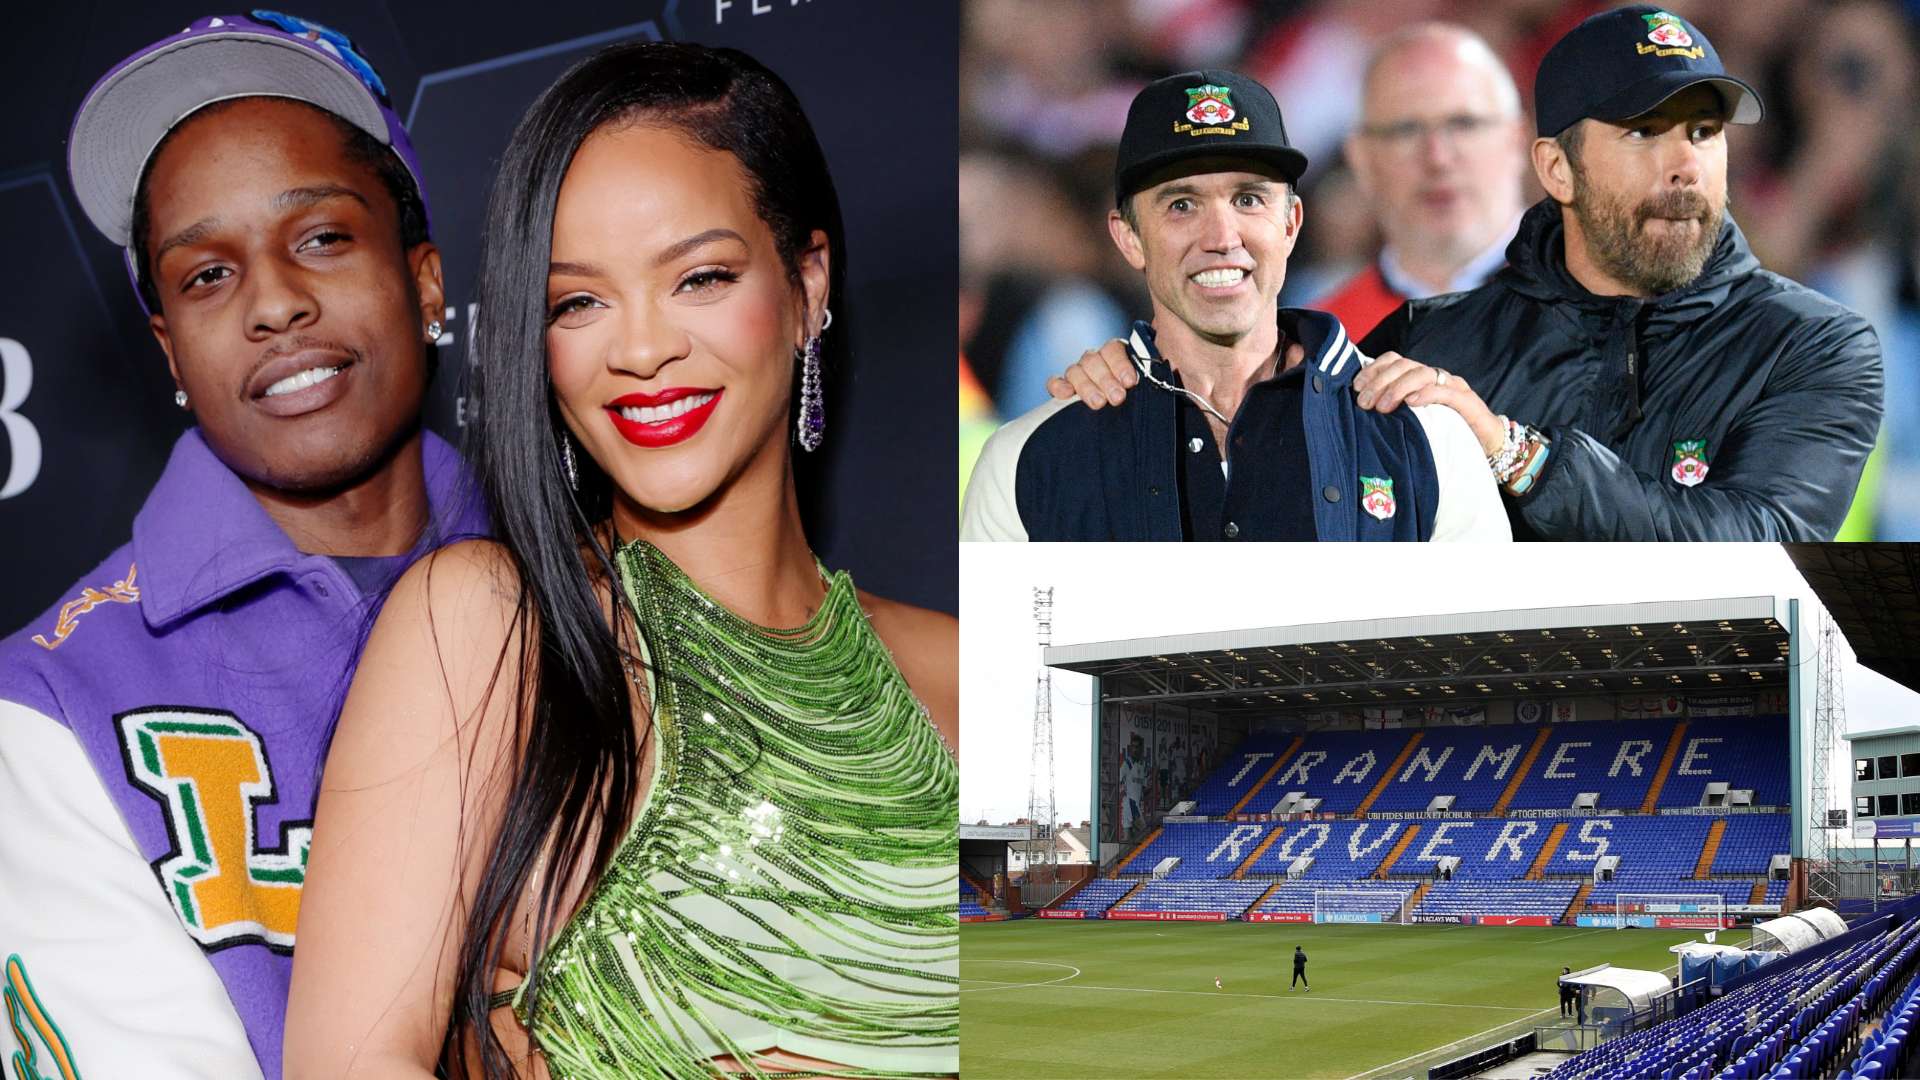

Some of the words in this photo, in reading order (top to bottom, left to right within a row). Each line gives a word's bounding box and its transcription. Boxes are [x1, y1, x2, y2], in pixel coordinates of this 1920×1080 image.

[1227, 738, 1723, 787] TRANMERE
[1416, 811, 1431, 819] LUX
[1443, 811, 1472, 819] ROBUR
[112, 705, 315, 957] L
[1206, 820, 1613, 862] ROVERS
[1334, 913, 1367, 922] BARCLAYS
[1601, 916, 1640, 926] BARCLAYS
